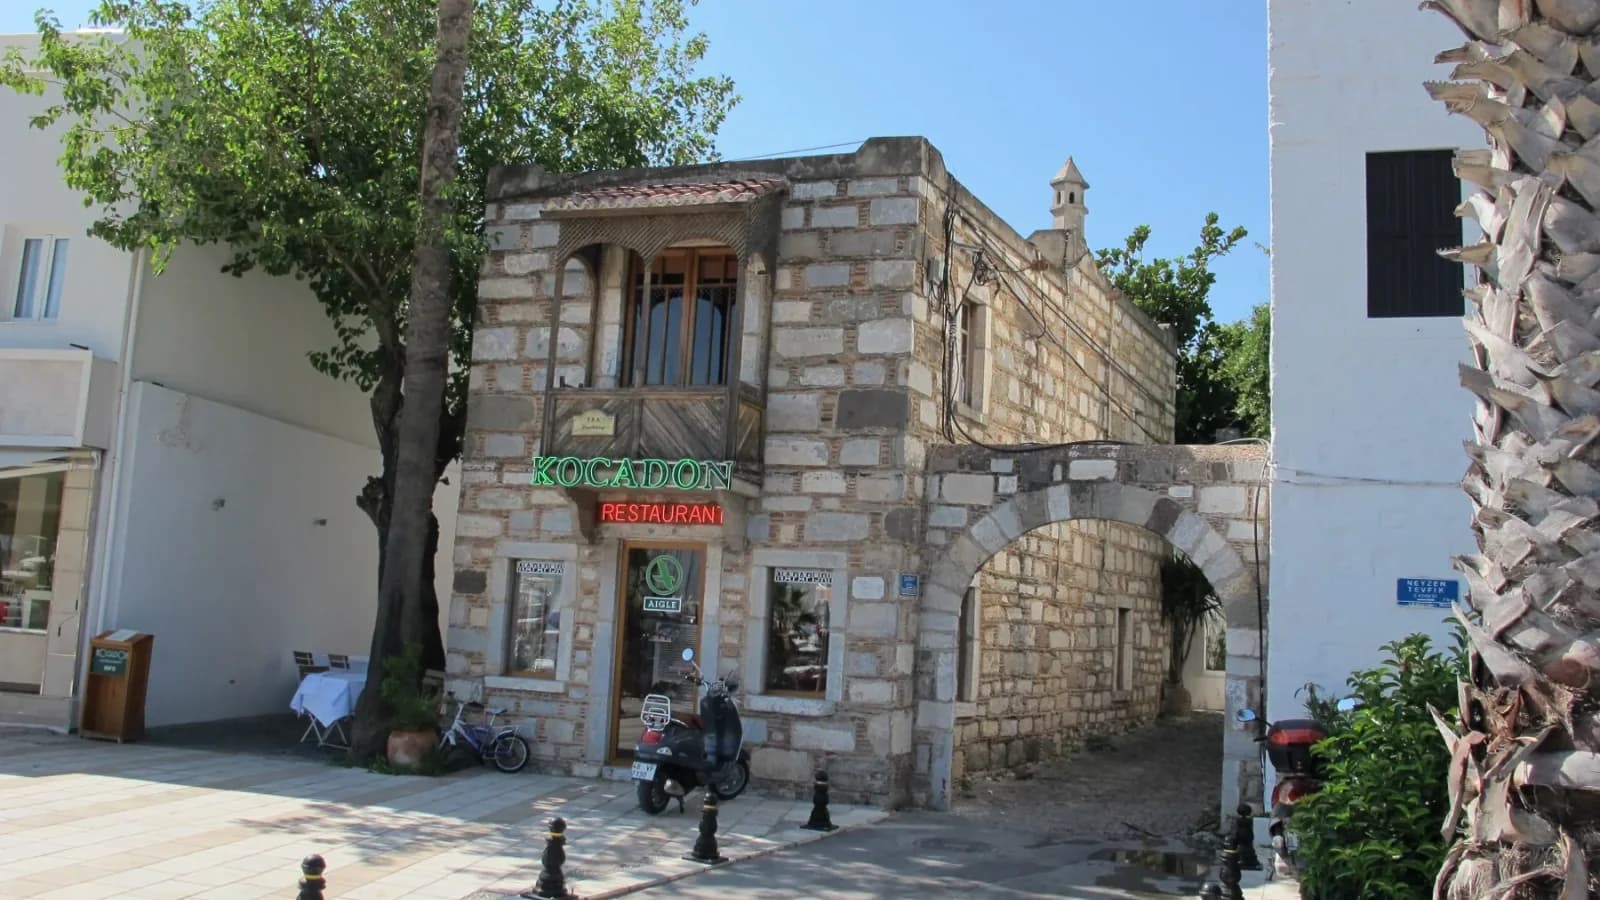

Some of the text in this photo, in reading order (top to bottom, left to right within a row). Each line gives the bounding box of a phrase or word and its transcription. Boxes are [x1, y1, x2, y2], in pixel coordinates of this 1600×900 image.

[531, 457, 734, 490] KOCADON
[601, 503, 725, 524] RESTAURANT
[647, 599, 678, 609] AIGLE
